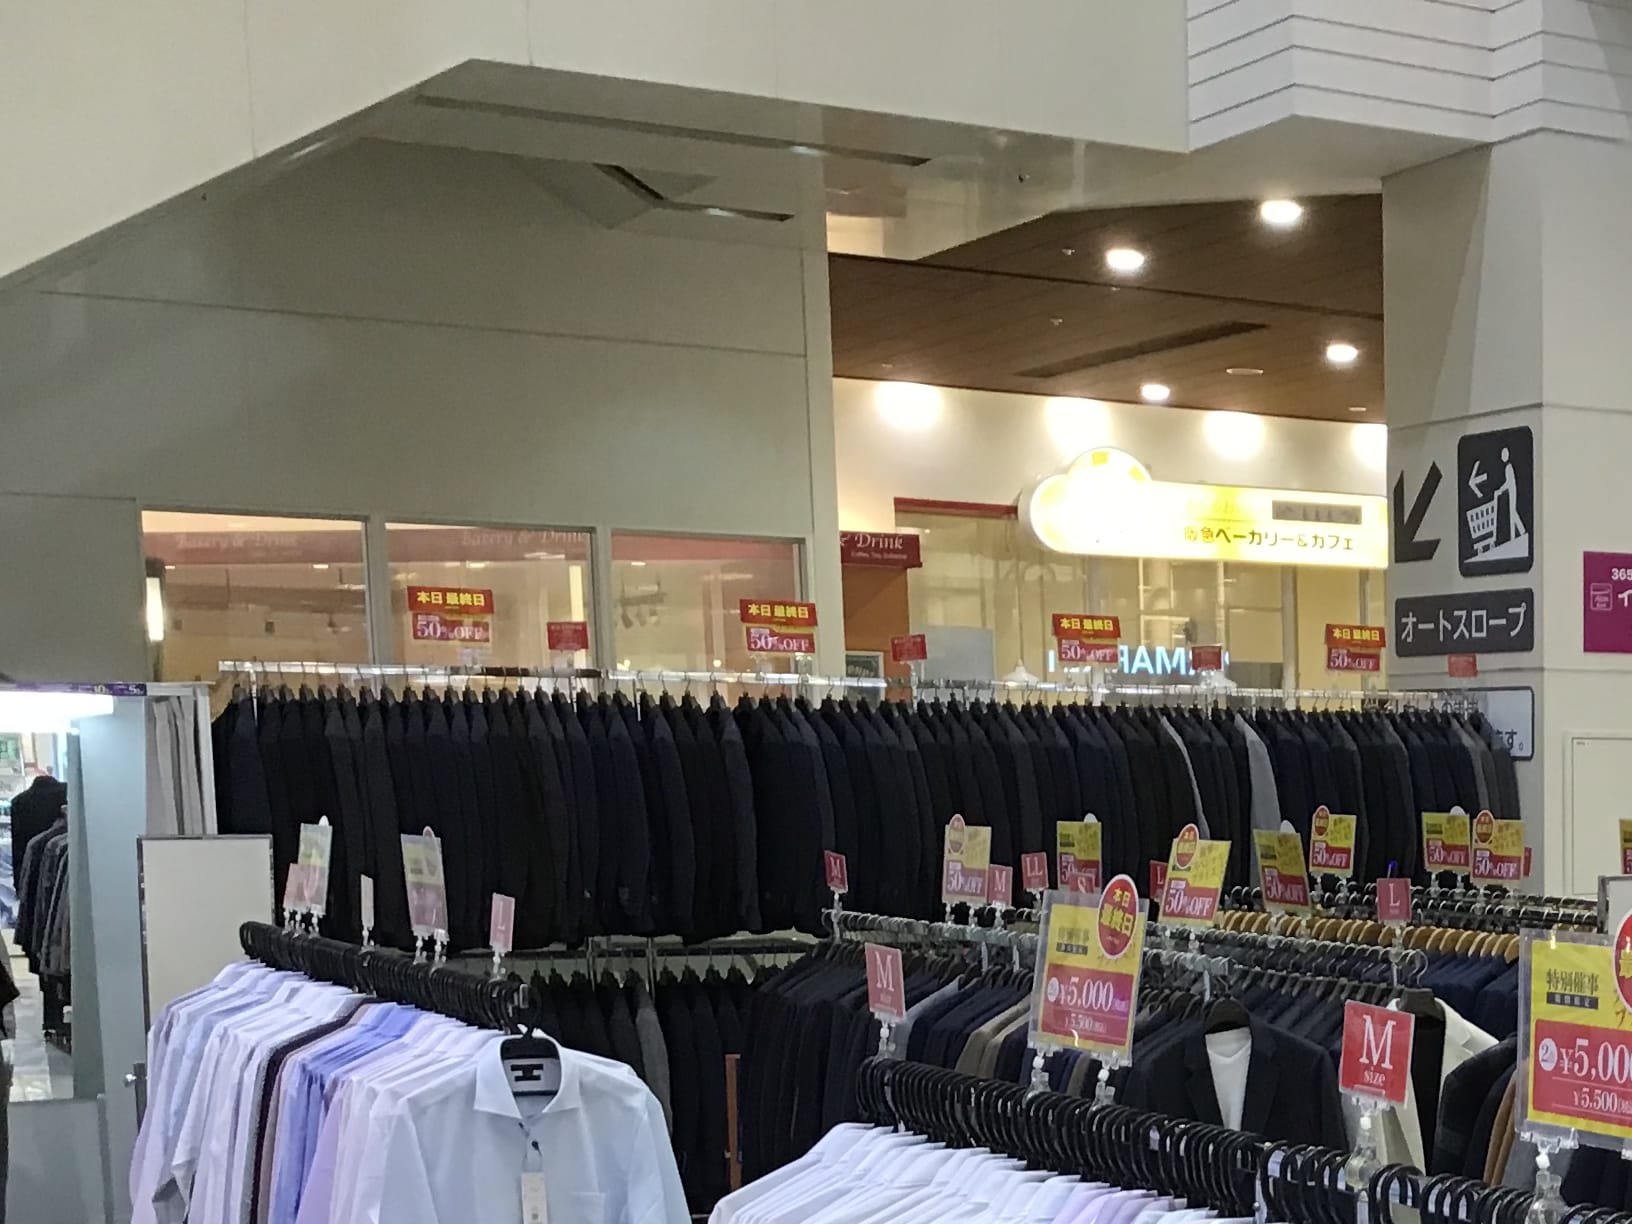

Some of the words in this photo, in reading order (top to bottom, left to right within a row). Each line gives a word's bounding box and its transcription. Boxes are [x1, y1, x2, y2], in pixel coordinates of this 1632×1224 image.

[854, 533, 903, 549] Drink
[416, 591, 443, 605] 本日
[748, 603, 771, 616] 本日
[1060, 617, 1081, 630] 本日
[1401, 602, 1527, 643] オートスロープ
[830, 856, 842, 878] M
[1026, 856, 1043, 877] LL
[994, 870, 1006, 892] M
[1389, 883, 1400, 906] L
[874, 951, 894, 992] M
[1359, 1014, 1397, 1070] M
[1363, 1066, 1386, 1087] size
